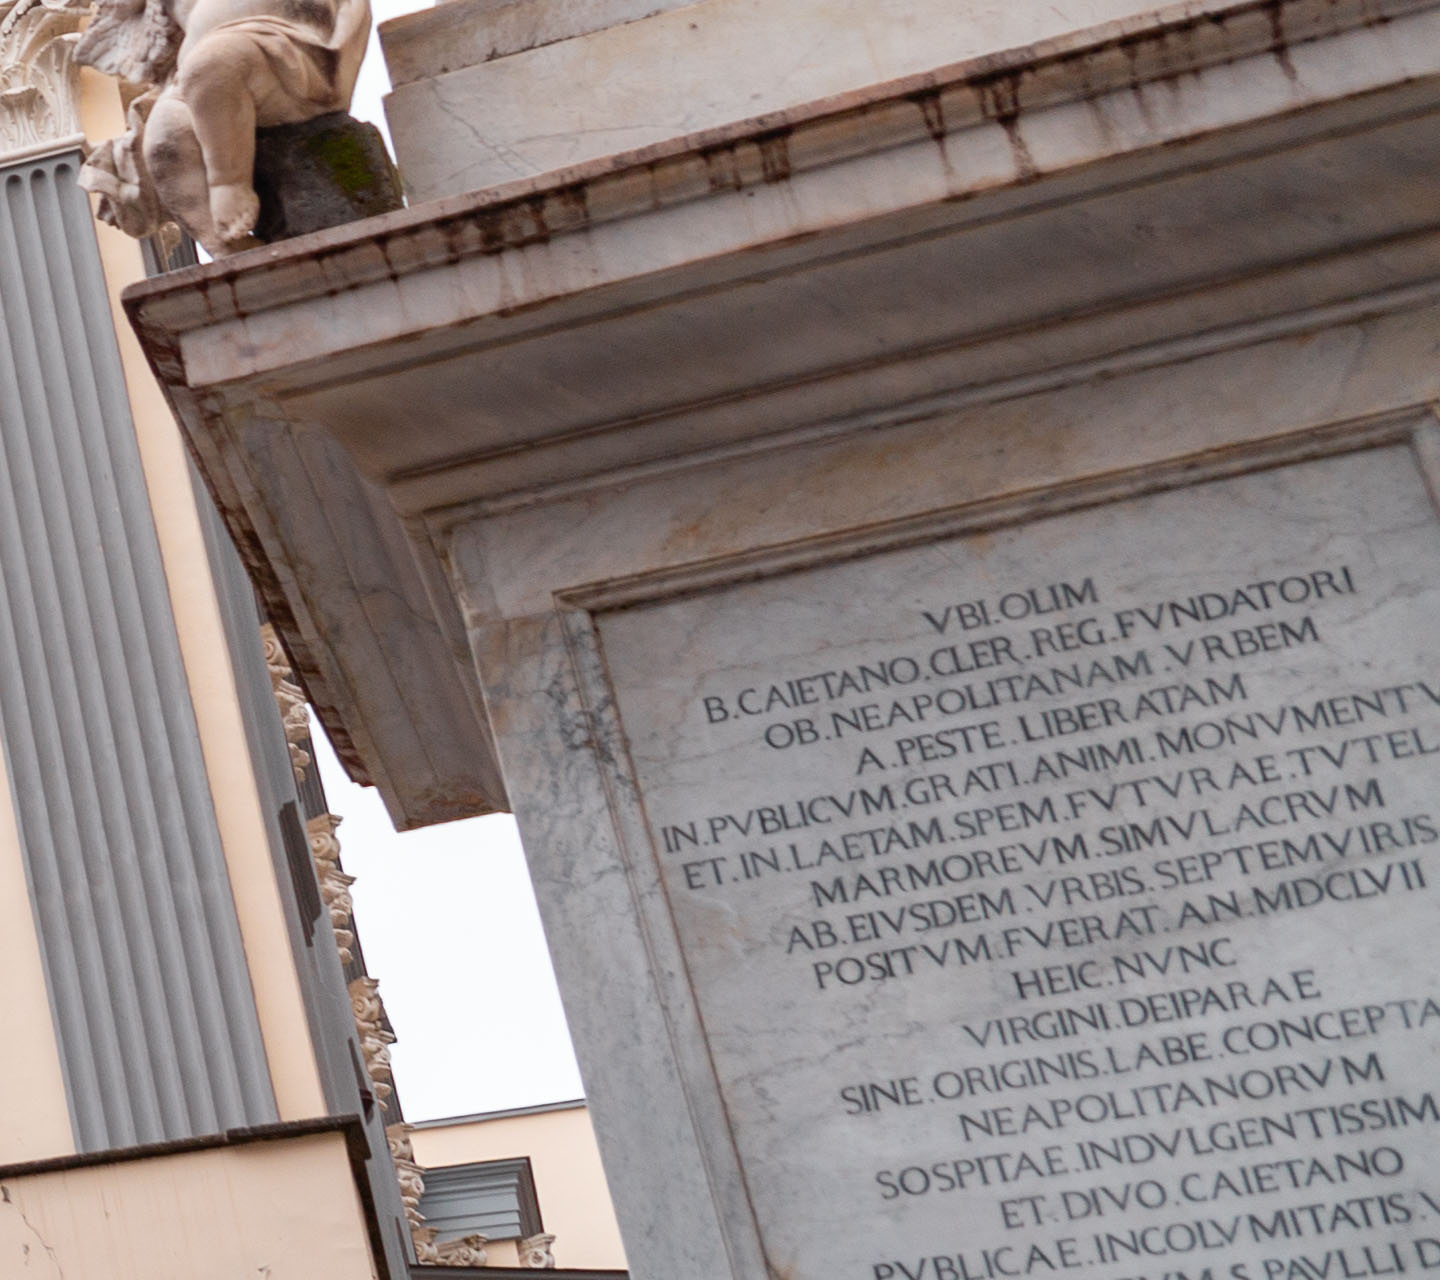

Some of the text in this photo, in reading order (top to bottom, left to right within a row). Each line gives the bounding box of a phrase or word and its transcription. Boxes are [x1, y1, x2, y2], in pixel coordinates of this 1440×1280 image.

[999, 577, 1099, 620] OLIM
[1115, 566, 1356, 639] FVNDATORI
[1166, 616, 1320, 666] VRBEM
[1018, 673, 1247, 742] LIBERATAM
[1099, 779, 1384, 855] SIMVLACRVM
[1154, 815, 1440, 889] SEPTEMVIRIS
[1252, 860, 1426, 915] MDCLVII
[1112, 938, 1237, 984] NVNC
[1118, 969, 1321, 1027] DEIPARAE
[959, 1053, 1385, 1141] NEAPOLITANORVM
[1180, 1147, 1404, 1202] CAIETANO
